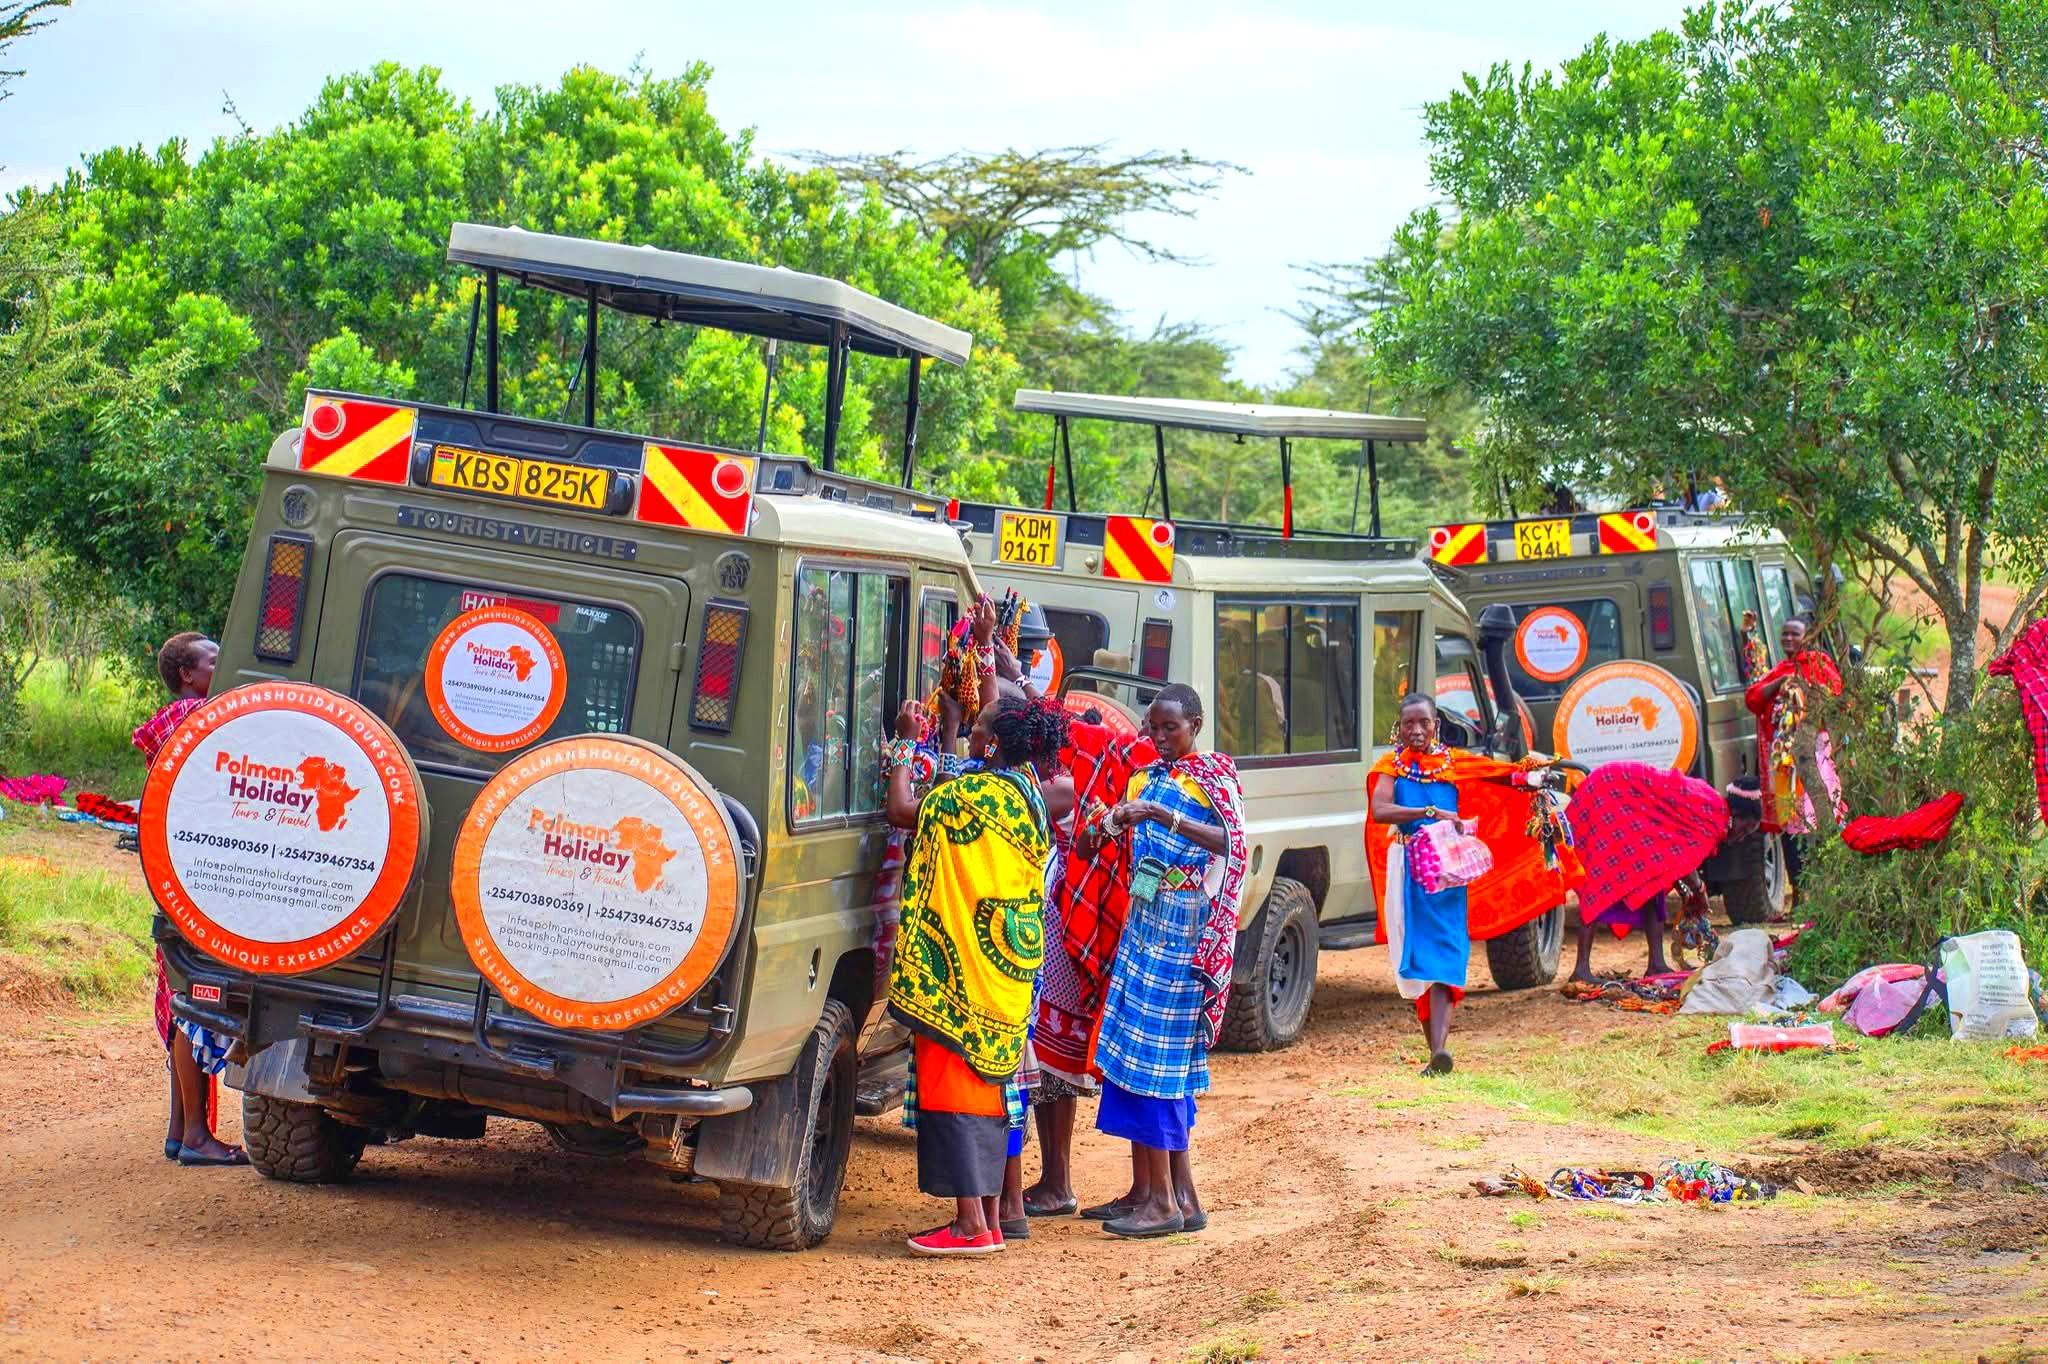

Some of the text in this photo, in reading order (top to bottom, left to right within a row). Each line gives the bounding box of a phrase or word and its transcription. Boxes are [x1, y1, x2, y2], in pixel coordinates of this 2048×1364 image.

[453, 453, 600, 505] KBS 825K
[409, 509, 627, 558] TOURIST VEHICLE
[1015, 518, 1052, 540] KDM
[1520, 523, 1553, 542] KCY
[1004, 540, 1050, 563] 916T
[1521, 541, 1568, 559] 044L
[473, 654, 515, 673] Holiday
[1596, 714, 1640, 727] Holiday
[462, 732, 492, 748] UNIQUE
[495, 723, 541, 748] EXPERIENCE
[229, 776, 314, 813] Holiday
[231, 801, 312, 828] Tours & Travel
[172, 830, 269, 855] +254703890369
[279, 847, 376, 873] +254739467354
[544, 833, 630, 873] Holiday
[579, 866, 592, 881] &
[485, 887, 584, 914] +254703890369
[594, 907, 693, 934] +254739467354
[162, 880, 371, 968] SELLING UNIQUE EXPERIENCE
[196, 987, 217, 999] HAL
[474, 936, 688, 1026] SELLING UNIQUE EXPERIENCE
